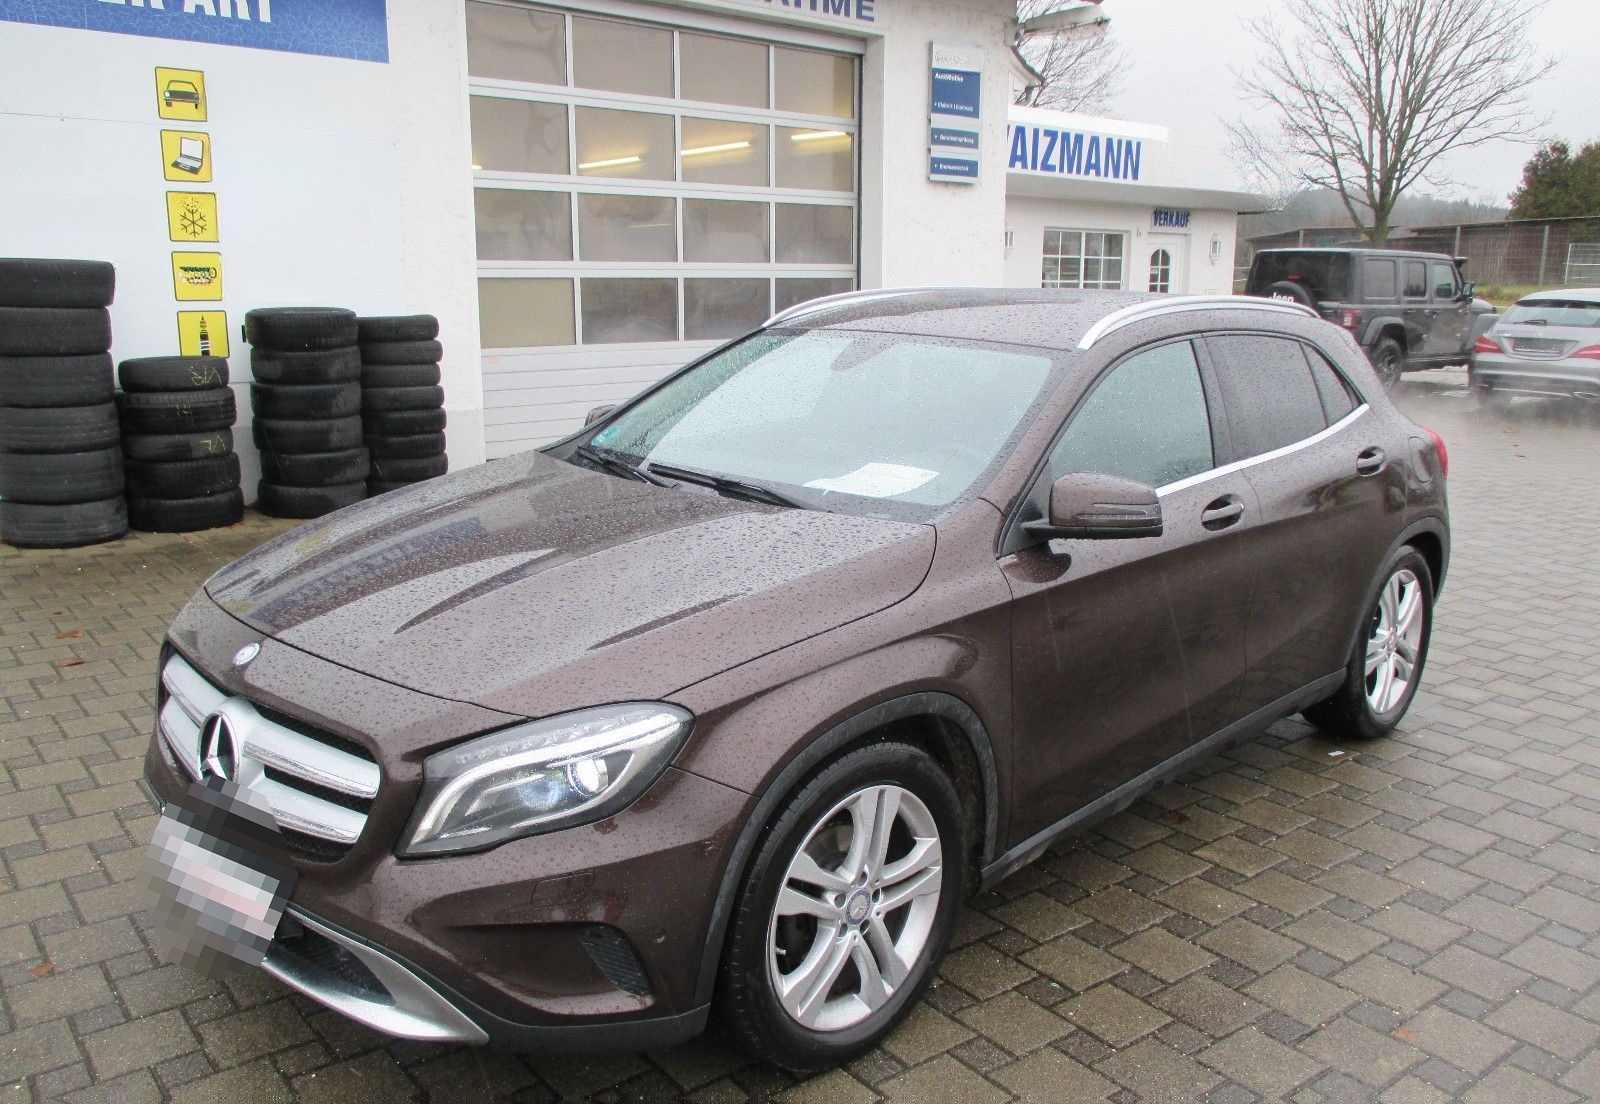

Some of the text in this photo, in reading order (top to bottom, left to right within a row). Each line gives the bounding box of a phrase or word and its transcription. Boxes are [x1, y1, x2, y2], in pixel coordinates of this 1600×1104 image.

[764, 0, 875, 22] ME
[1007, 124, 1142, 181] AIZMANN
[1153, 209, 1191, 228] VERKAUF
